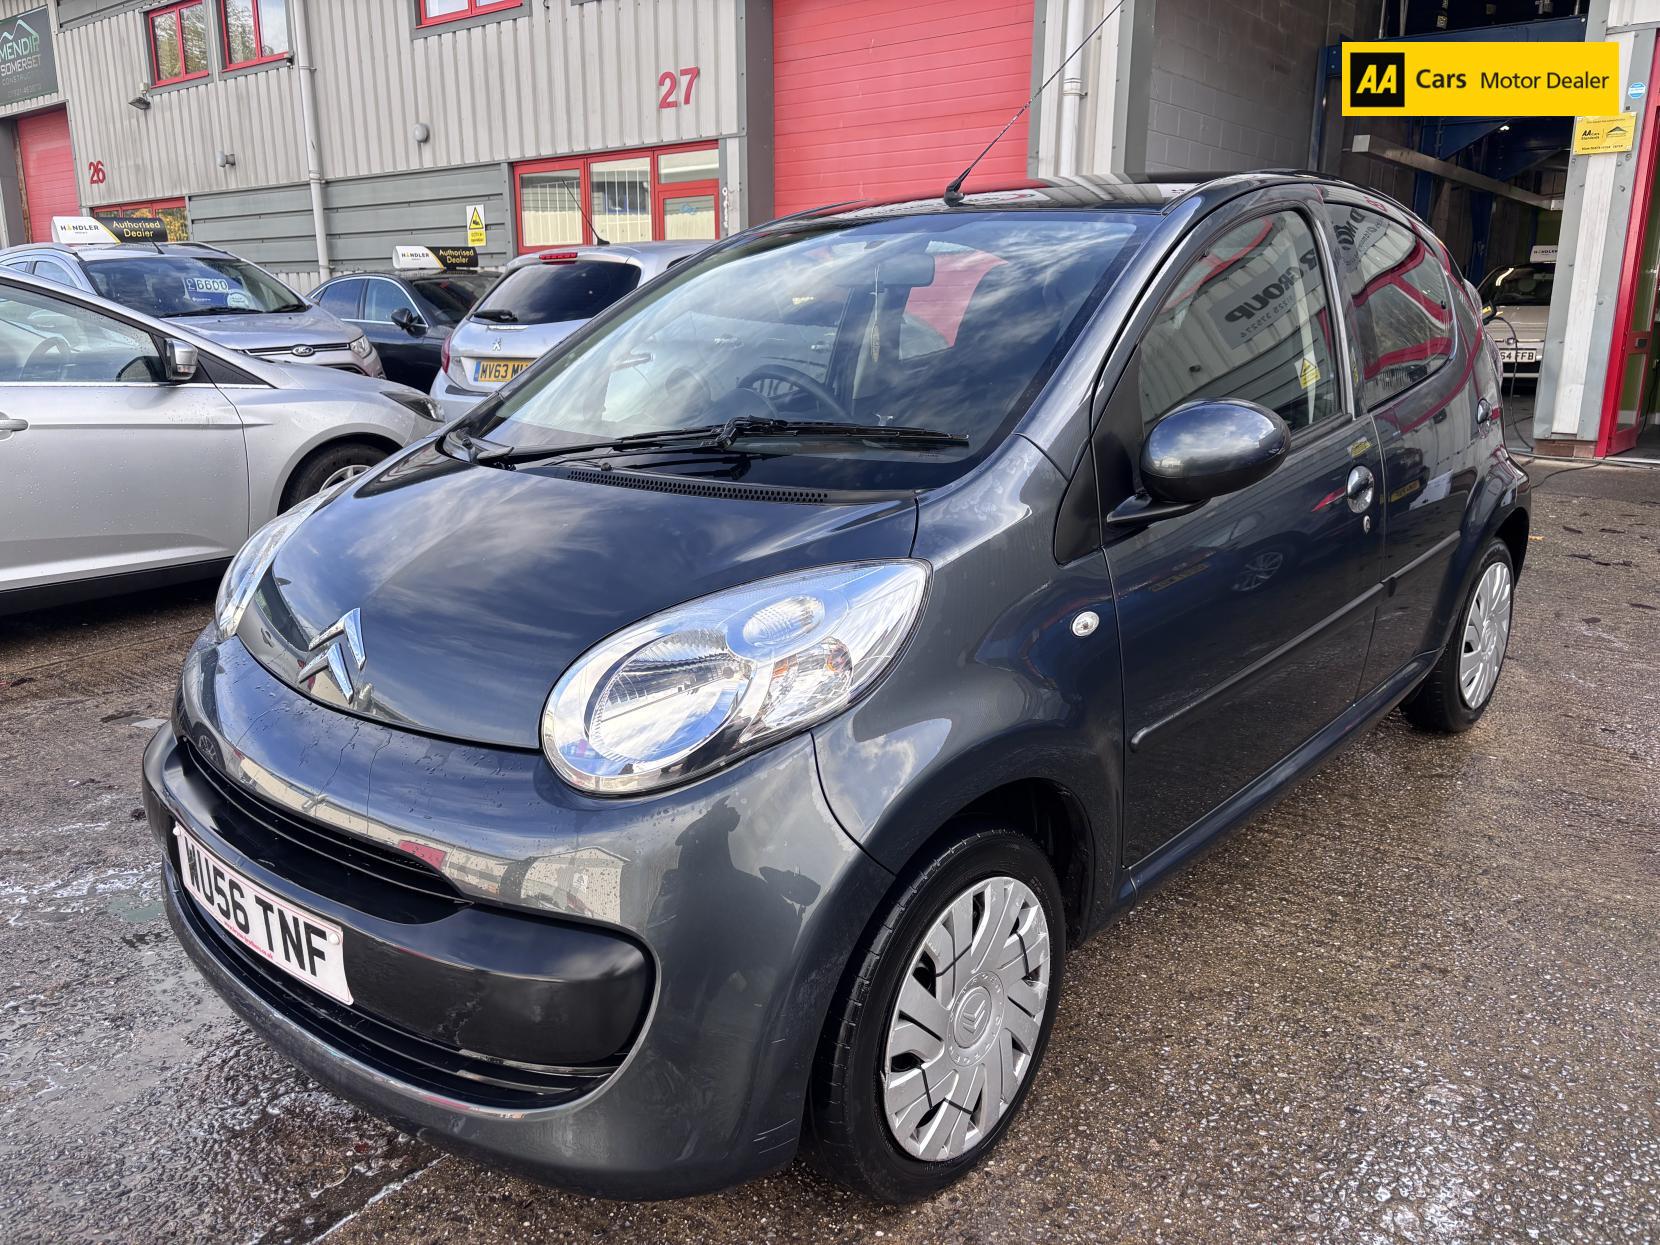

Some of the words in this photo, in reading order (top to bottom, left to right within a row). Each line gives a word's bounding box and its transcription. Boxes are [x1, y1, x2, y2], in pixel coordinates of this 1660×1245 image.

[1, 54, 41, 76] SOMERSET
[658, 66, 699, 109] 27
[88, 160, 106, 185] 26
[113, 220, 161, 230] Authorised
[124, 228, 154, 238] Dealer
[439, 249, 474, 257] Authorised
[446, 256, 469, 264] Dealer
[481, 363, 509, 379] MV63
[255, 895, 327, 977] TNF
